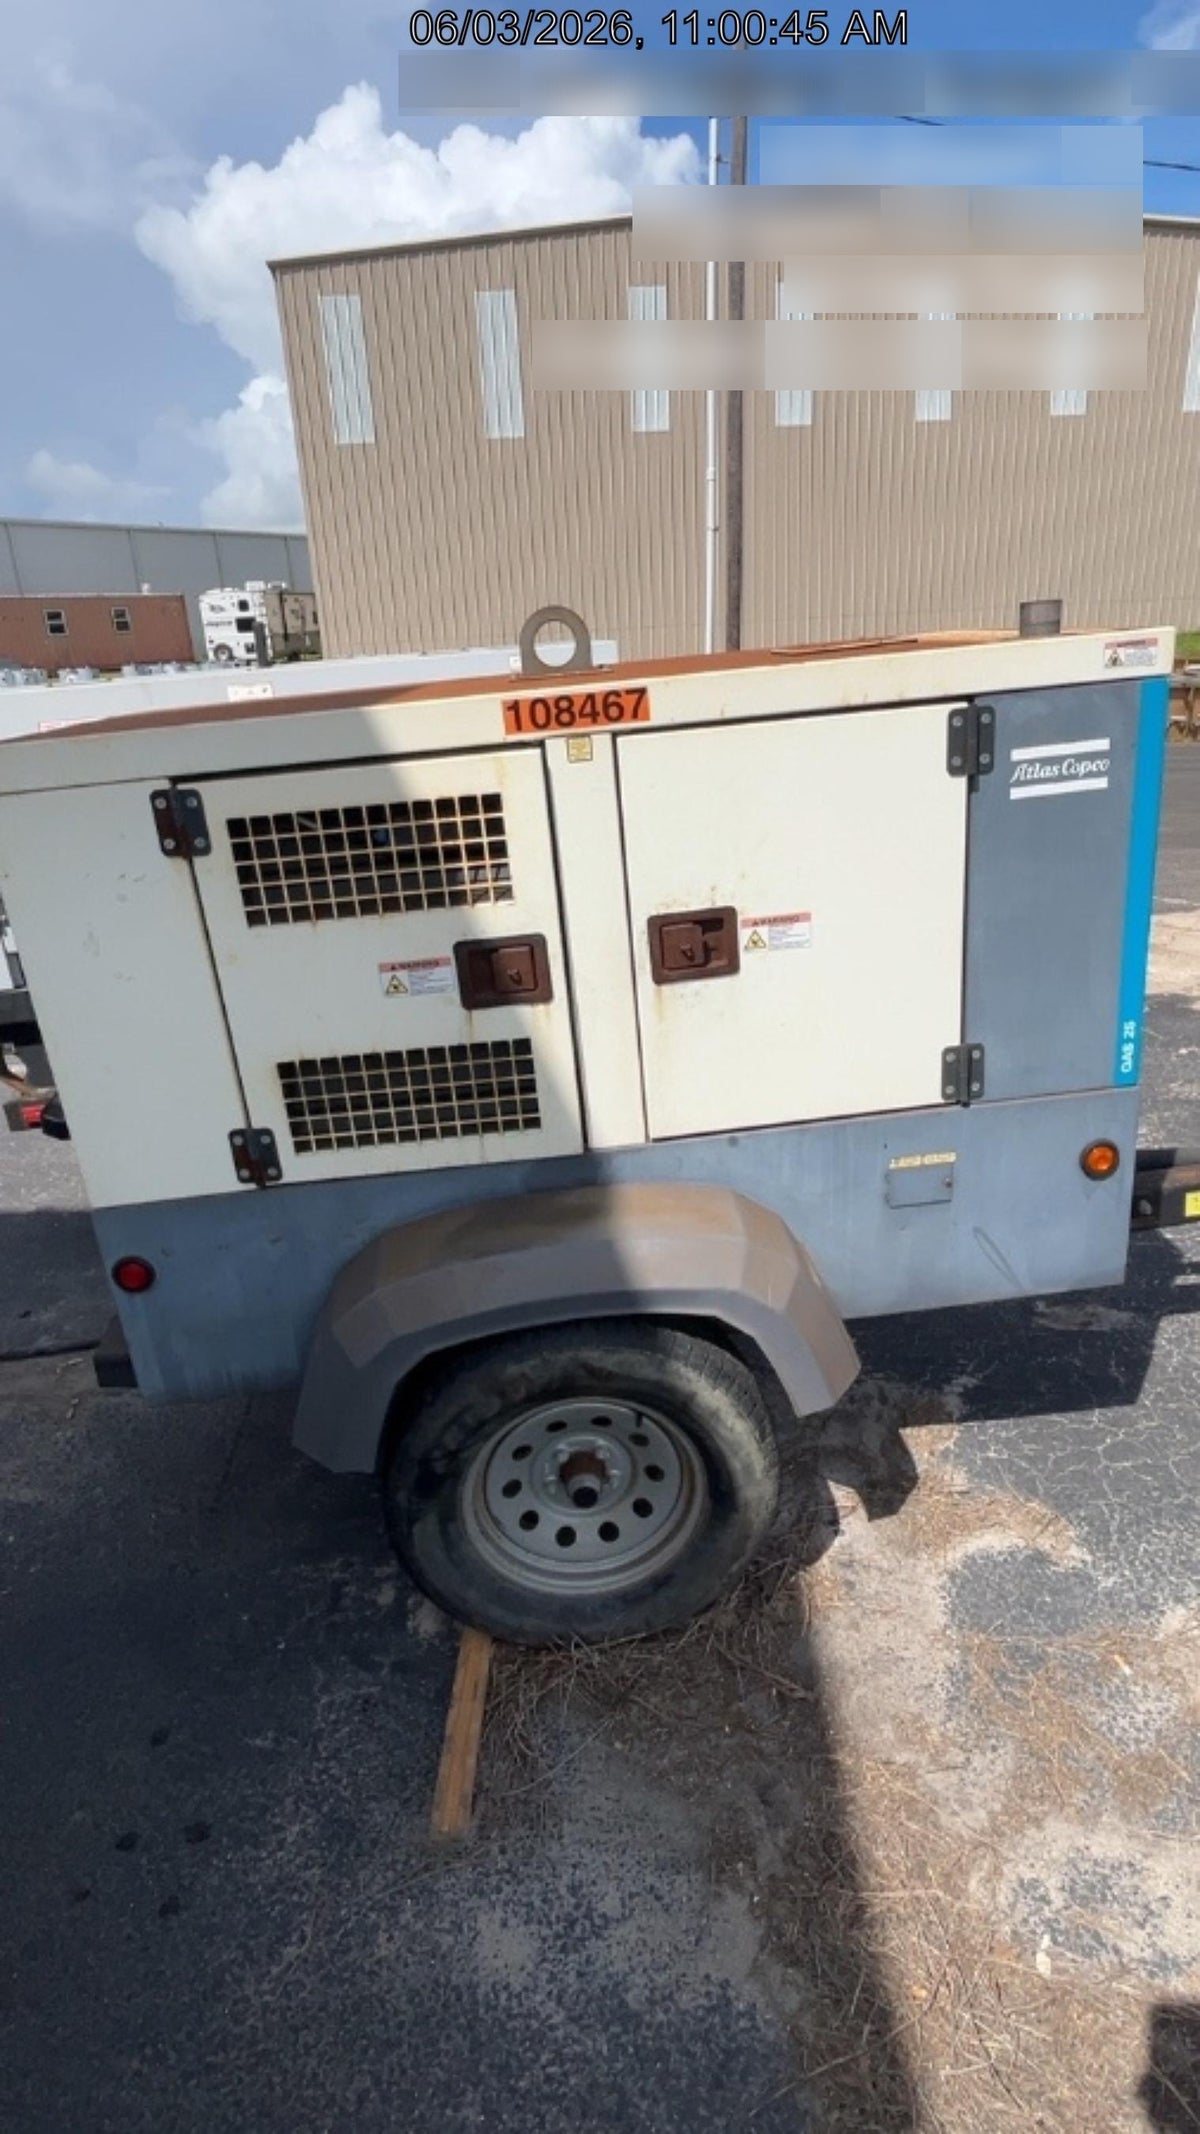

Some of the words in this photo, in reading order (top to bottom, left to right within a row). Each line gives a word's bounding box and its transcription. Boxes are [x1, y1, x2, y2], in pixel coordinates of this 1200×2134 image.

[506, 687, 647, 732] 108467
[1010, 762, 1060, 783] Atlas
[1062, 757, 1111, 777] Copco
[1123, 1020, 1137, 1040] 25
